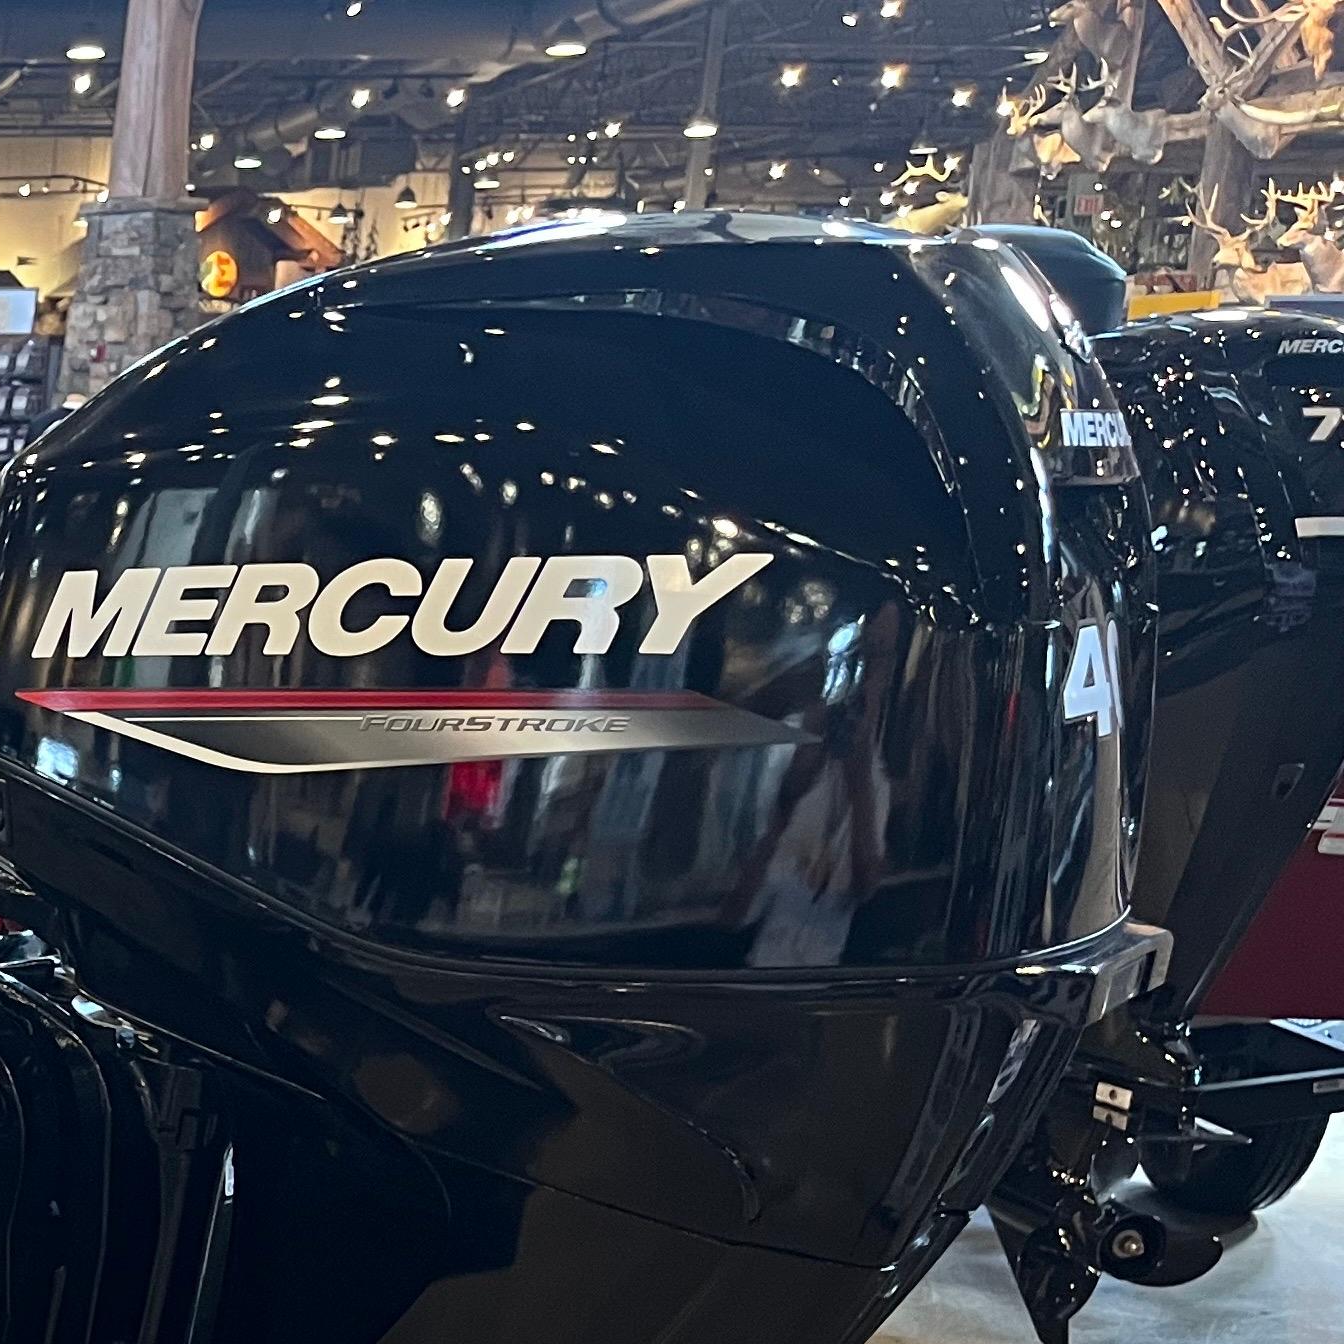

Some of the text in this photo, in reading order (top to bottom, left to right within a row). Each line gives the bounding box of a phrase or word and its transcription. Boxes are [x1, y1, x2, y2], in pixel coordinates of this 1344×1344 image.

[1277, 338, 1344, 355] MERC
[31, 553, 774, 659] MERCURY
[1063, 619, 1125, 738] 4
